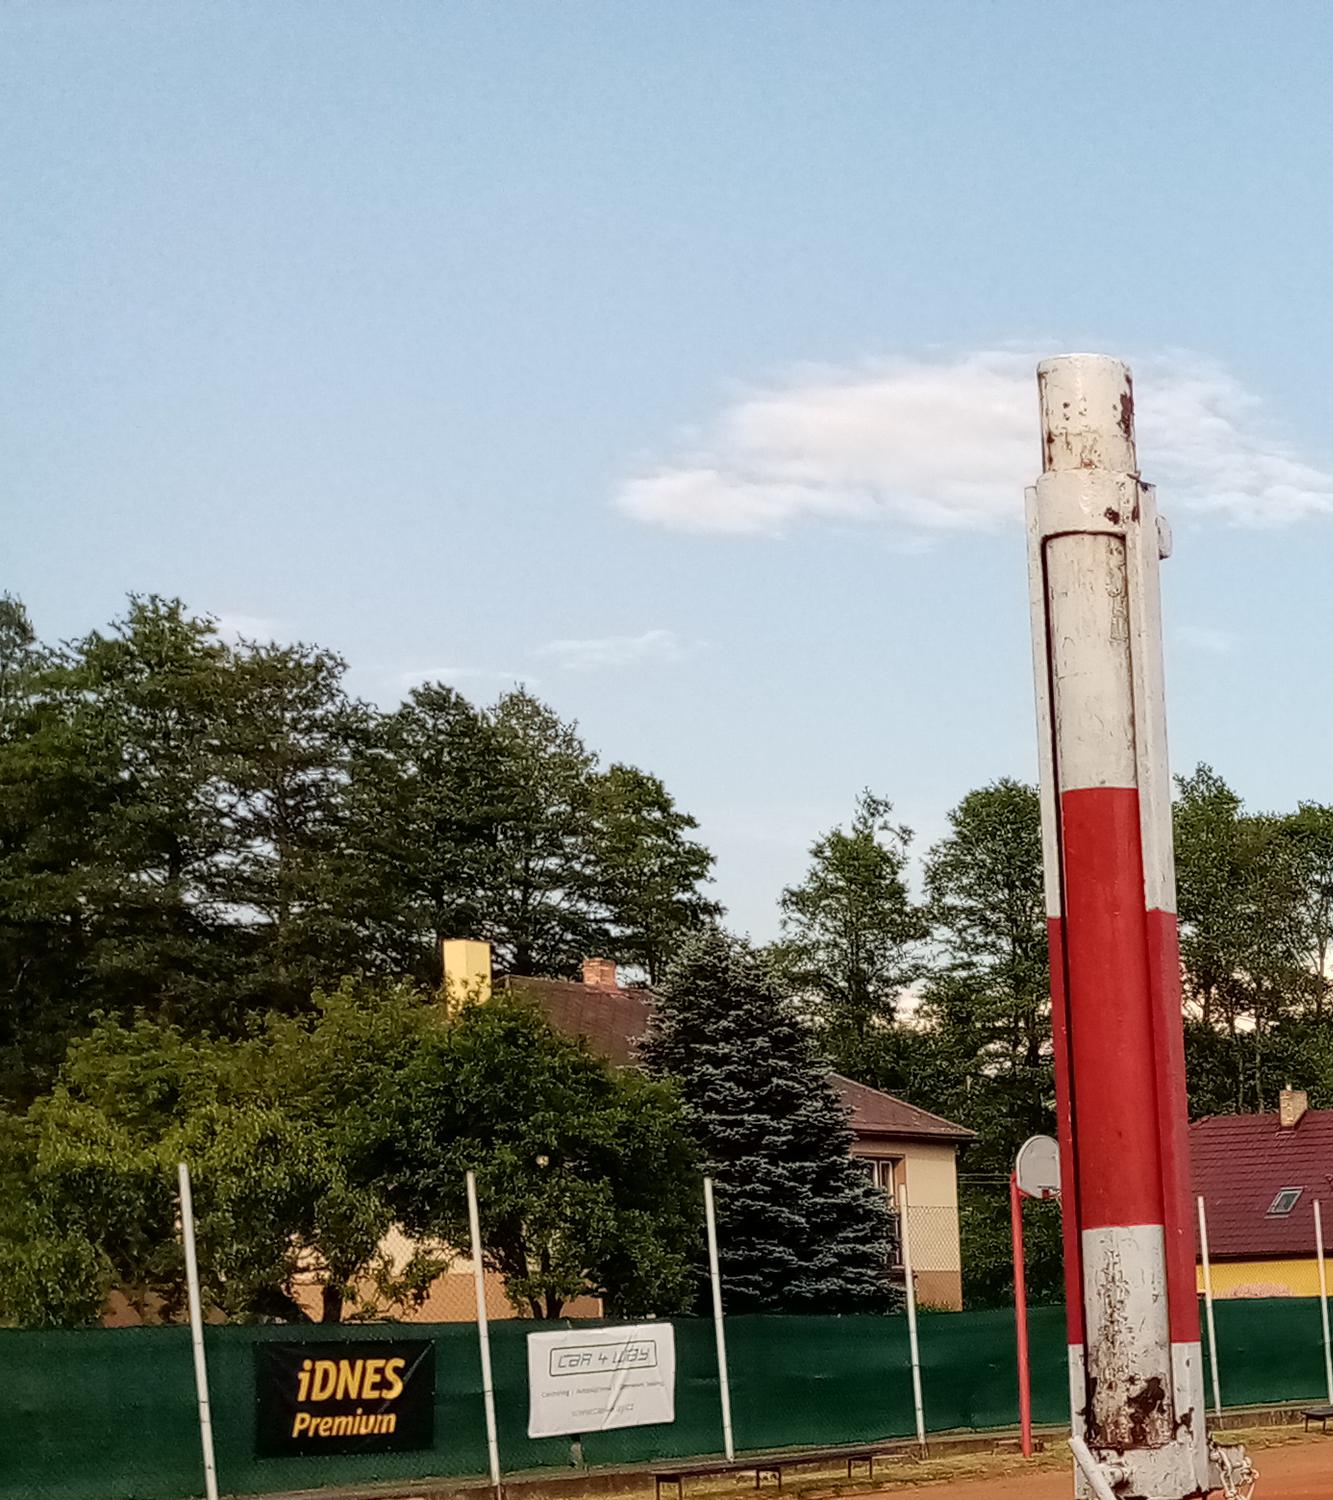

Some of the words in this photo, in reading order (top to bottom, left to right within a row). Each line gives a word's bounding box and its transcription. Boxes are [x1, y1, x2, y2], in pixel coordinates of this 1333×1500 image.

[598, 1352, 608, 1365] 4
[297, 1358, 405, 1402] iDNES
[292, 1408, 396, 1438] Premium
